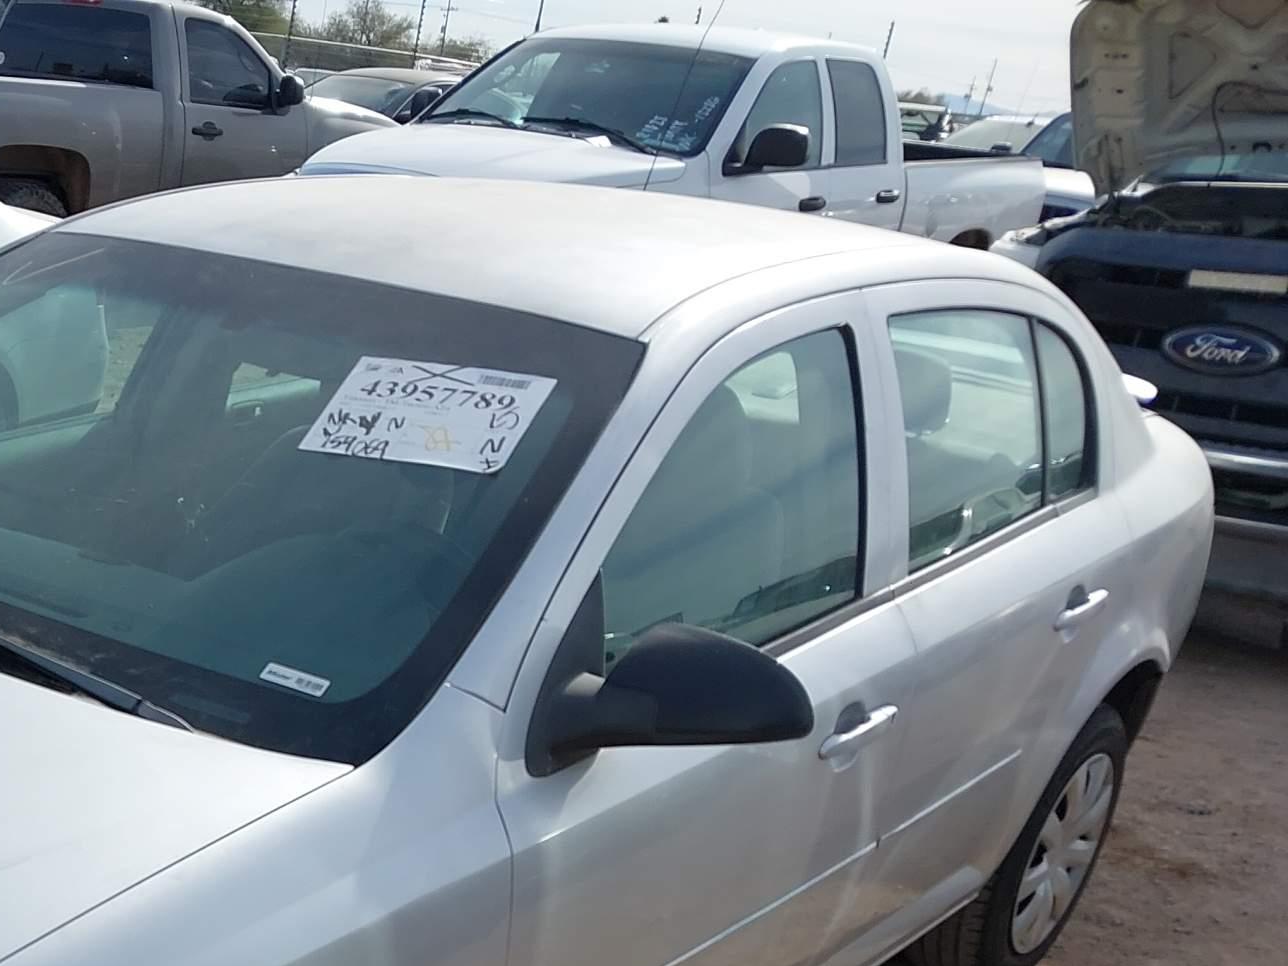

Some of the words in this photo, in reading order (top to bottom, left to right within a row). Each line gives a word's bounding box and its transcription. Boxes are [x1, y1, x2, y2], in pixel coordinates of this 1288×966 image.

[1185, 333, 1252, 365] Ford
[360, 379, 516, 411] 43957789
[479, 436, 506, 455] N
